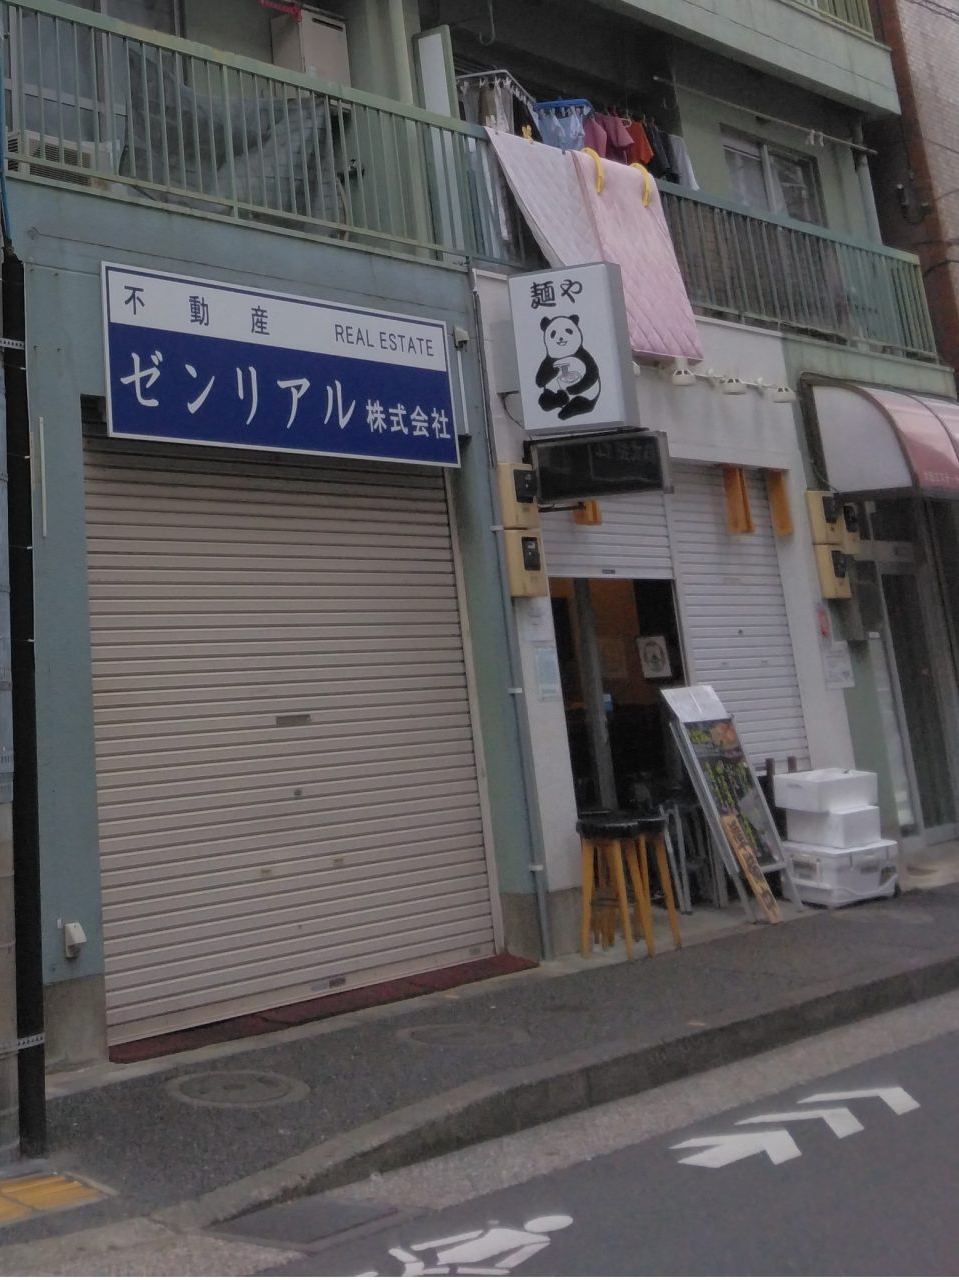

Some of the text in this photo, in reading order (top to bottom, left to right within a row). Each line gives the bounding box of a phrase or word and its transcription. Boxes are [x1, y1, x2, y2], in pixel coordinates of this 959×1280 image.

[124, 285, 270, 336] 不動産
[530, 279, 583, 309] 麺や
[334, 323, 434, 357] REAL ESTATE
[120, 350, 451, 440] ゼンリアル 株式会社
